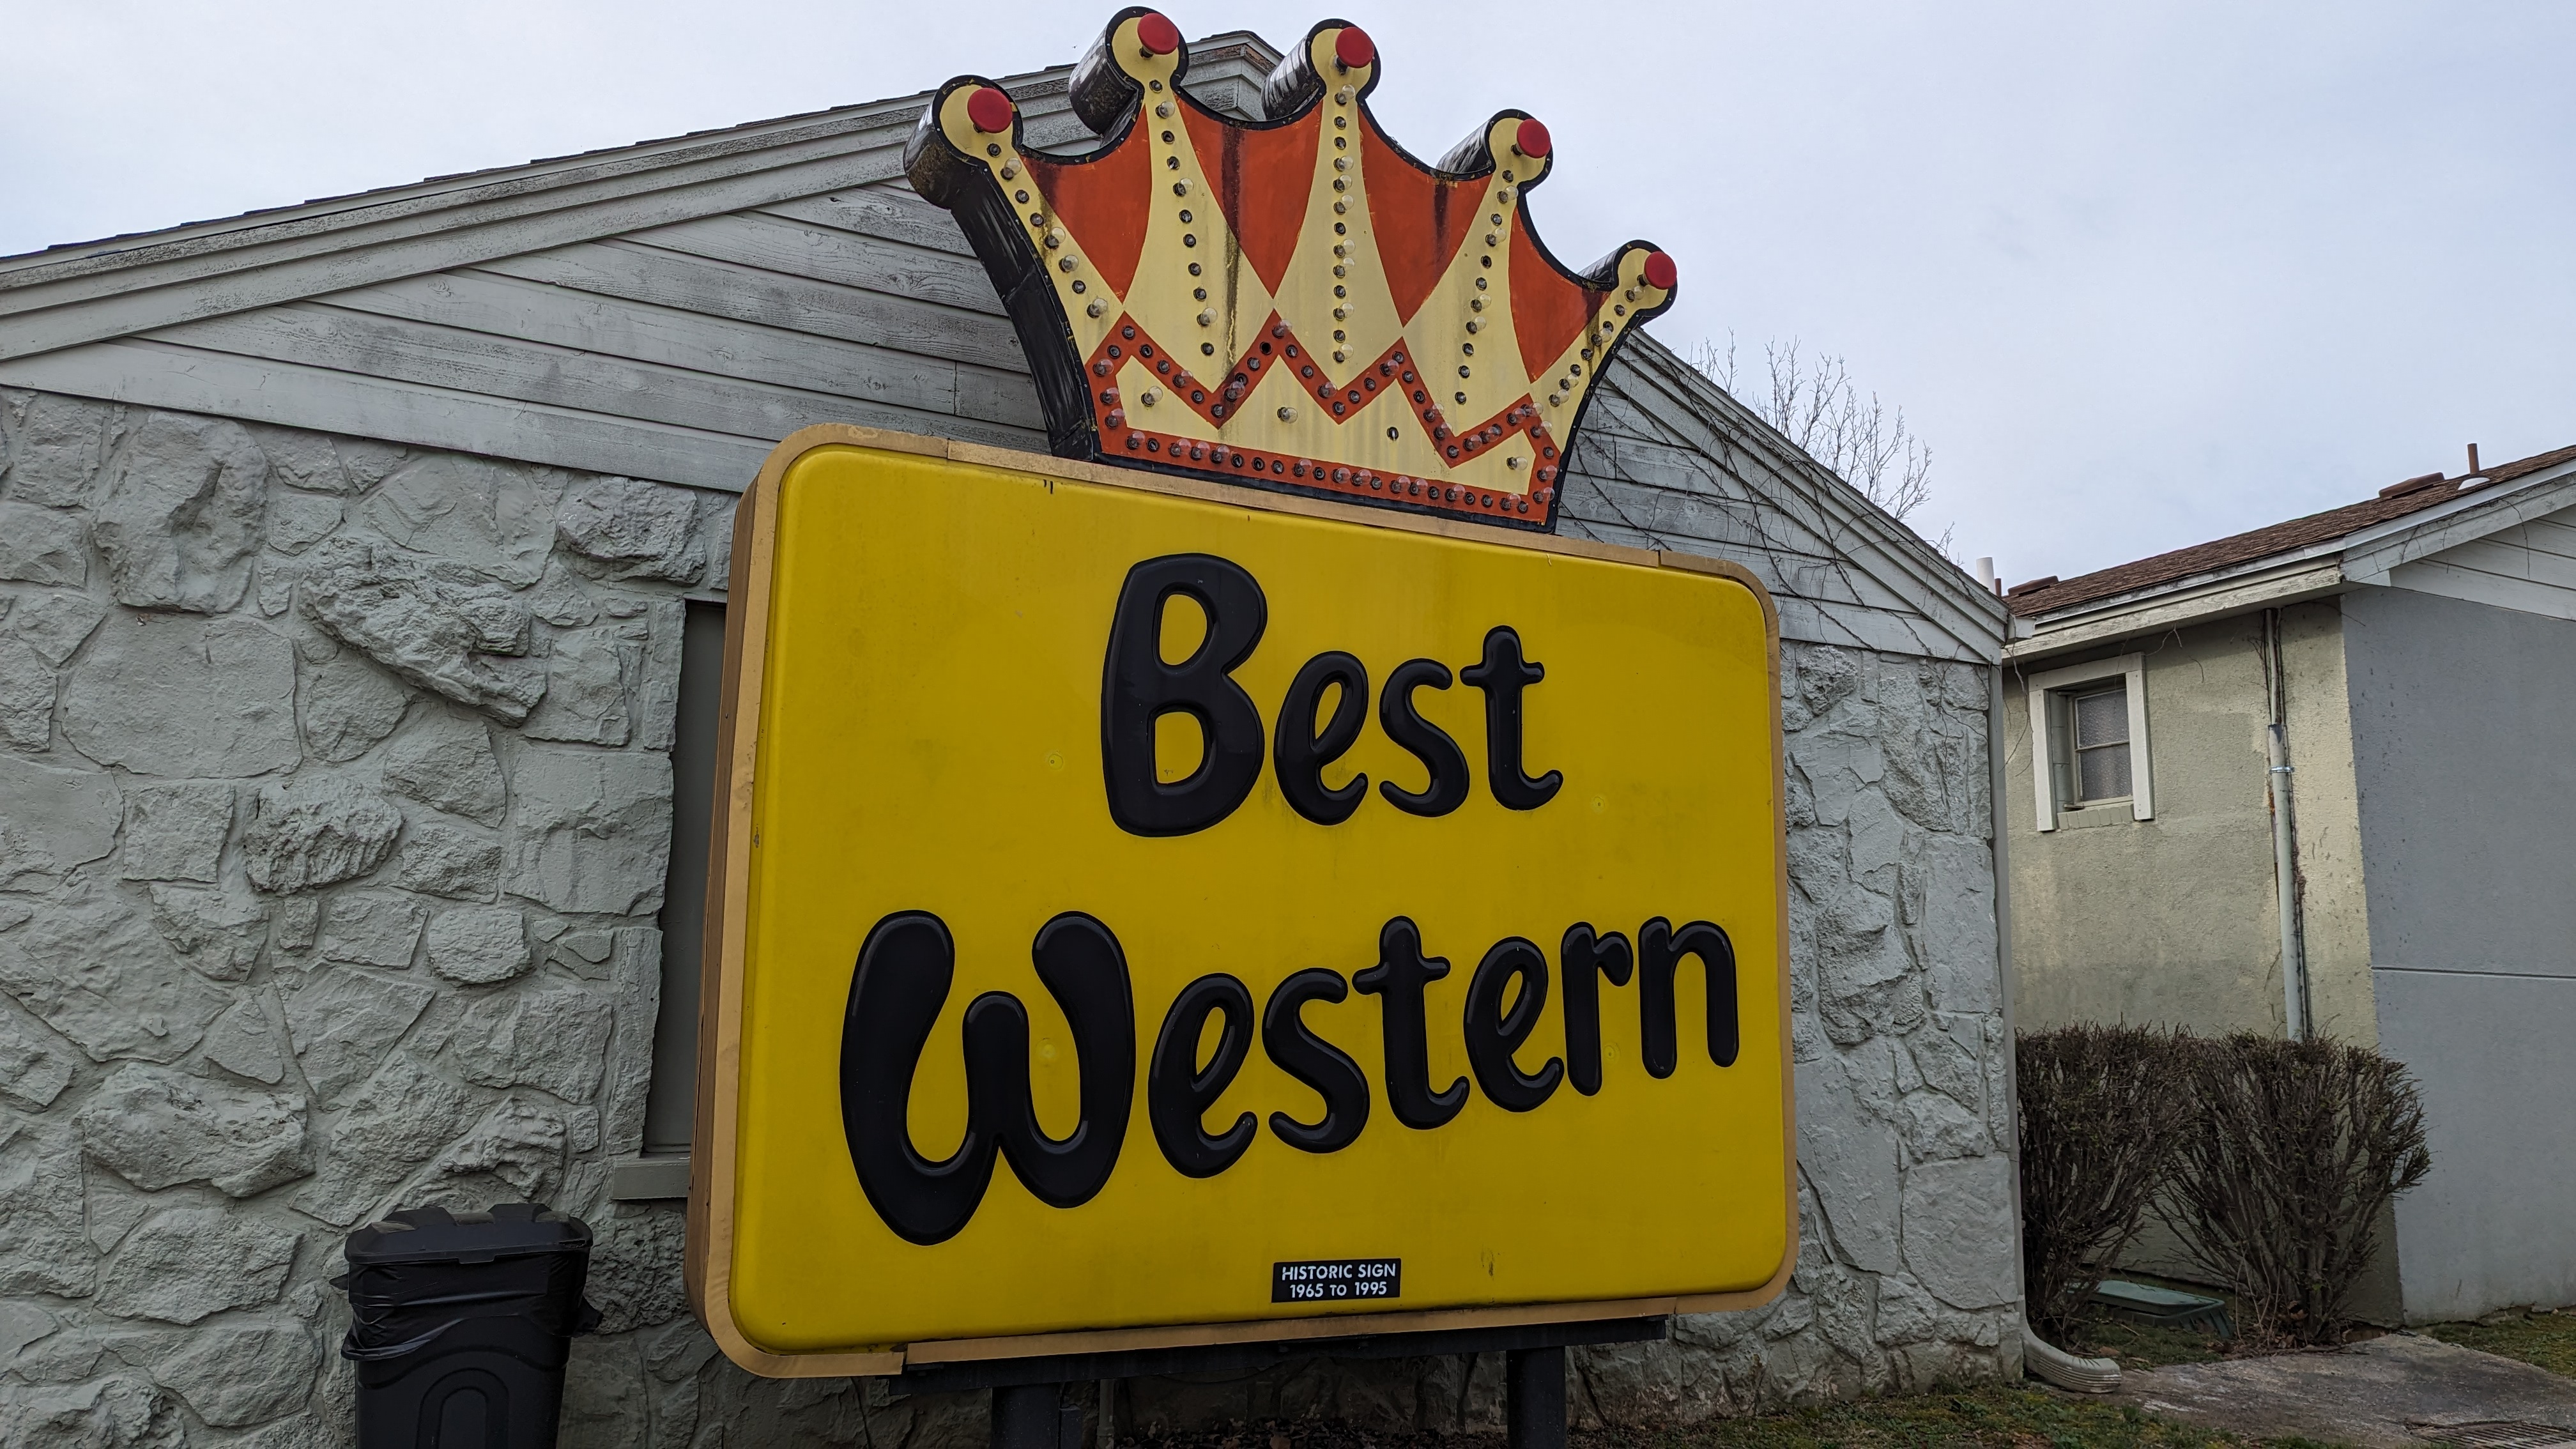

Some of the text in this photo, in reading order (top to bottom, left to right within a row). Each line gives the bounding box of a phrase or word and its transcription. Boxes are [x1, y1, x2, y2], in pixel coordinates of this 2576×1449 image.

[1100, 552, 1565, 838] Best
[838, 909, 1740, 1246] Western
[1282, 1263, 1396, 1280] HISTORIC SIGN
[1290, 1281, 1387, 1298] 1965 TO 1995
